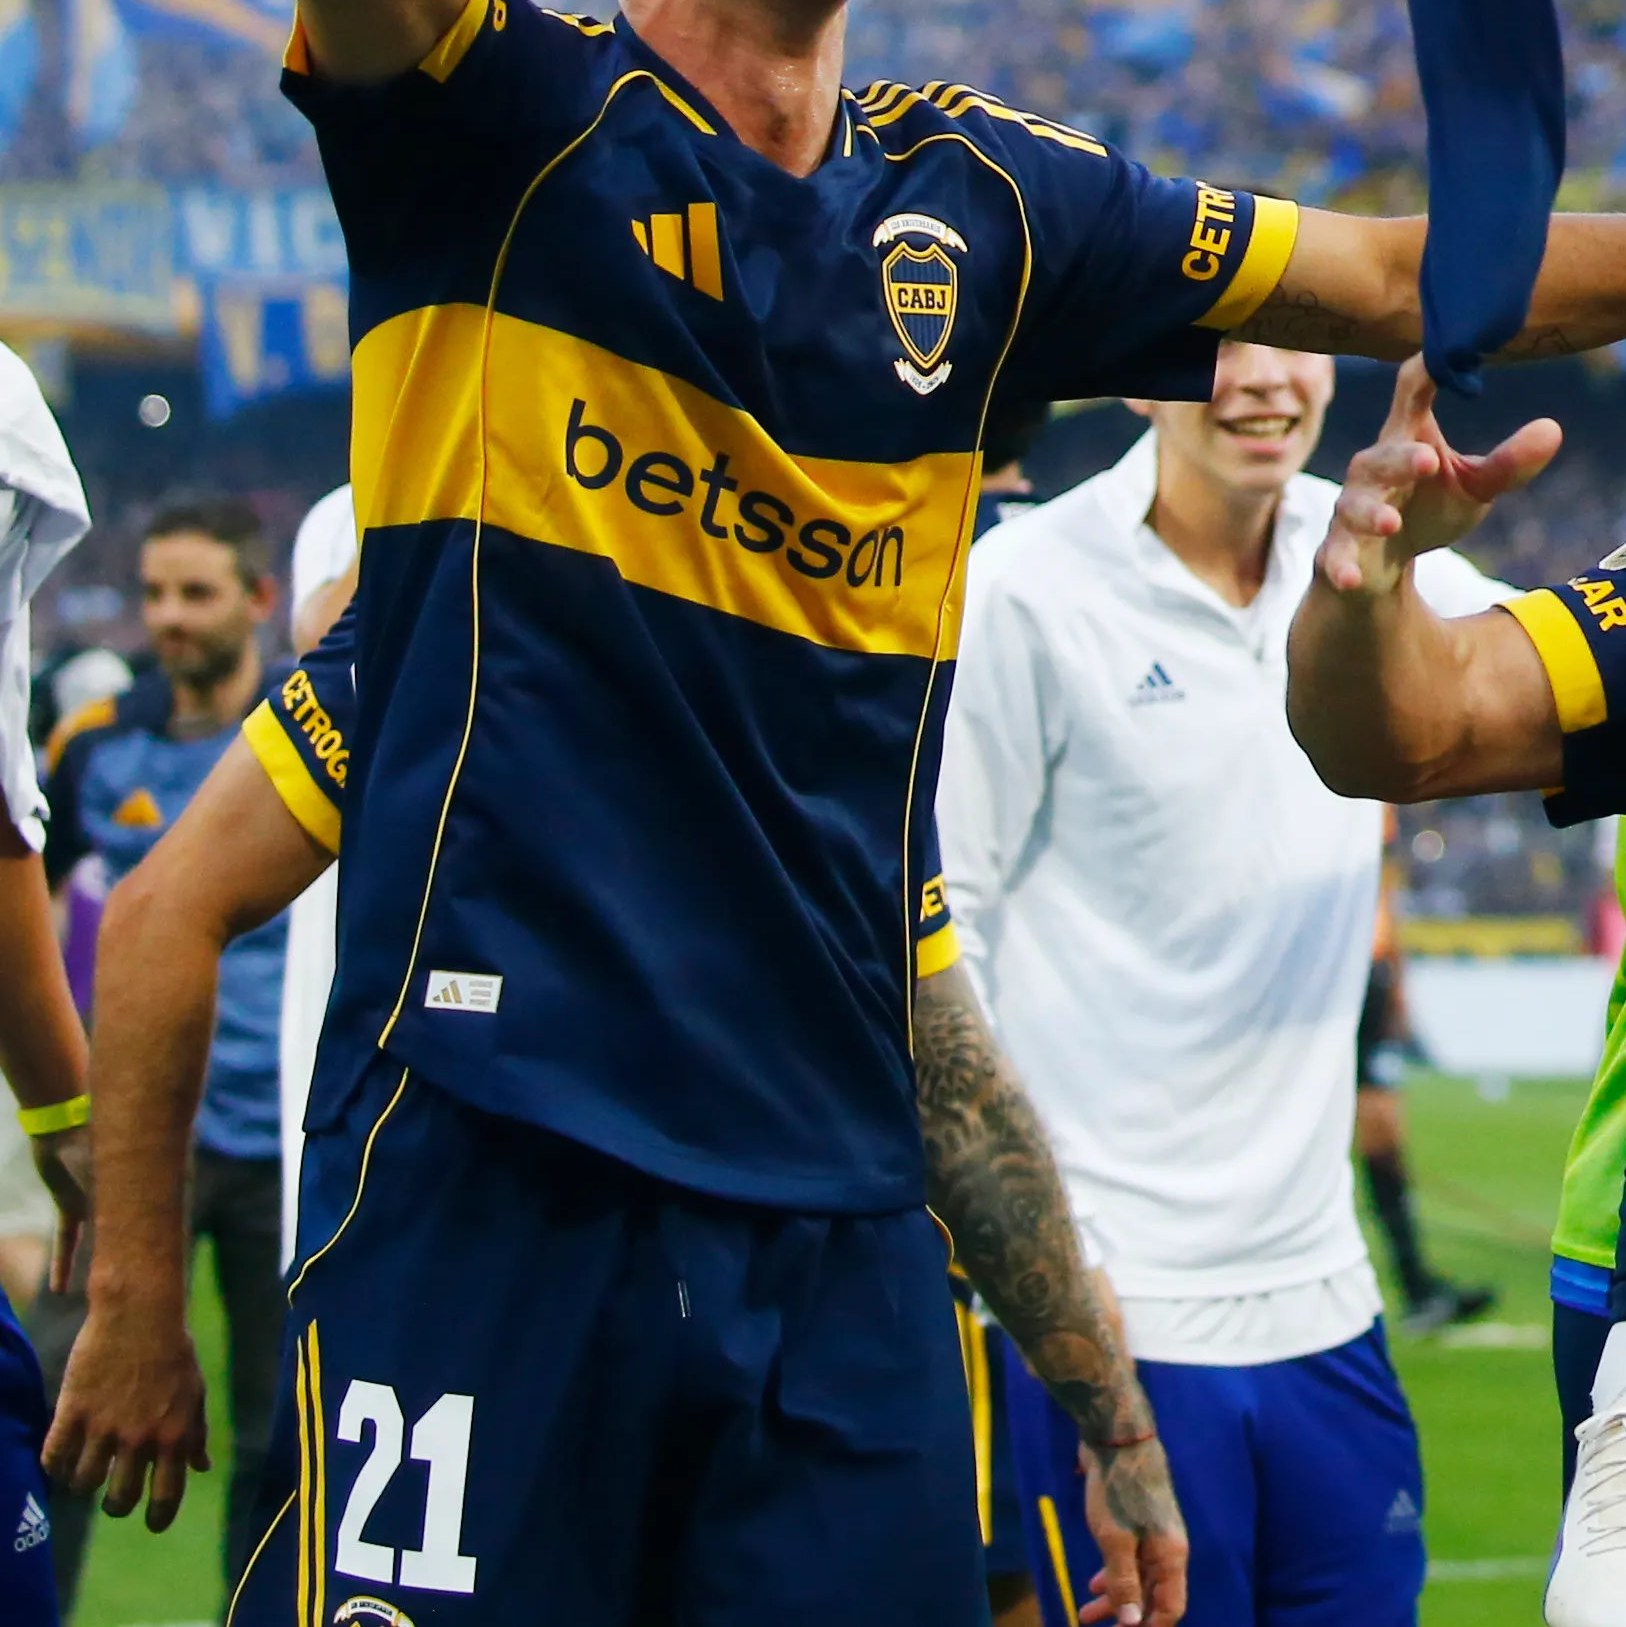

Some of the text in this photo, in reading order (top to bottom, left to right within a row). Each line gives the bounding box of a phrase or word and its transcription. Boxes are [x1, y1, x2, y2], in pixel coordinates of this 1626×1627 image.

[897, 288, 946, 310] CABJ
[1181, 180, 1236, 281] CETR
[564, 398, 904, 589] betsson
[335, 1379, 477, 1594] 21
